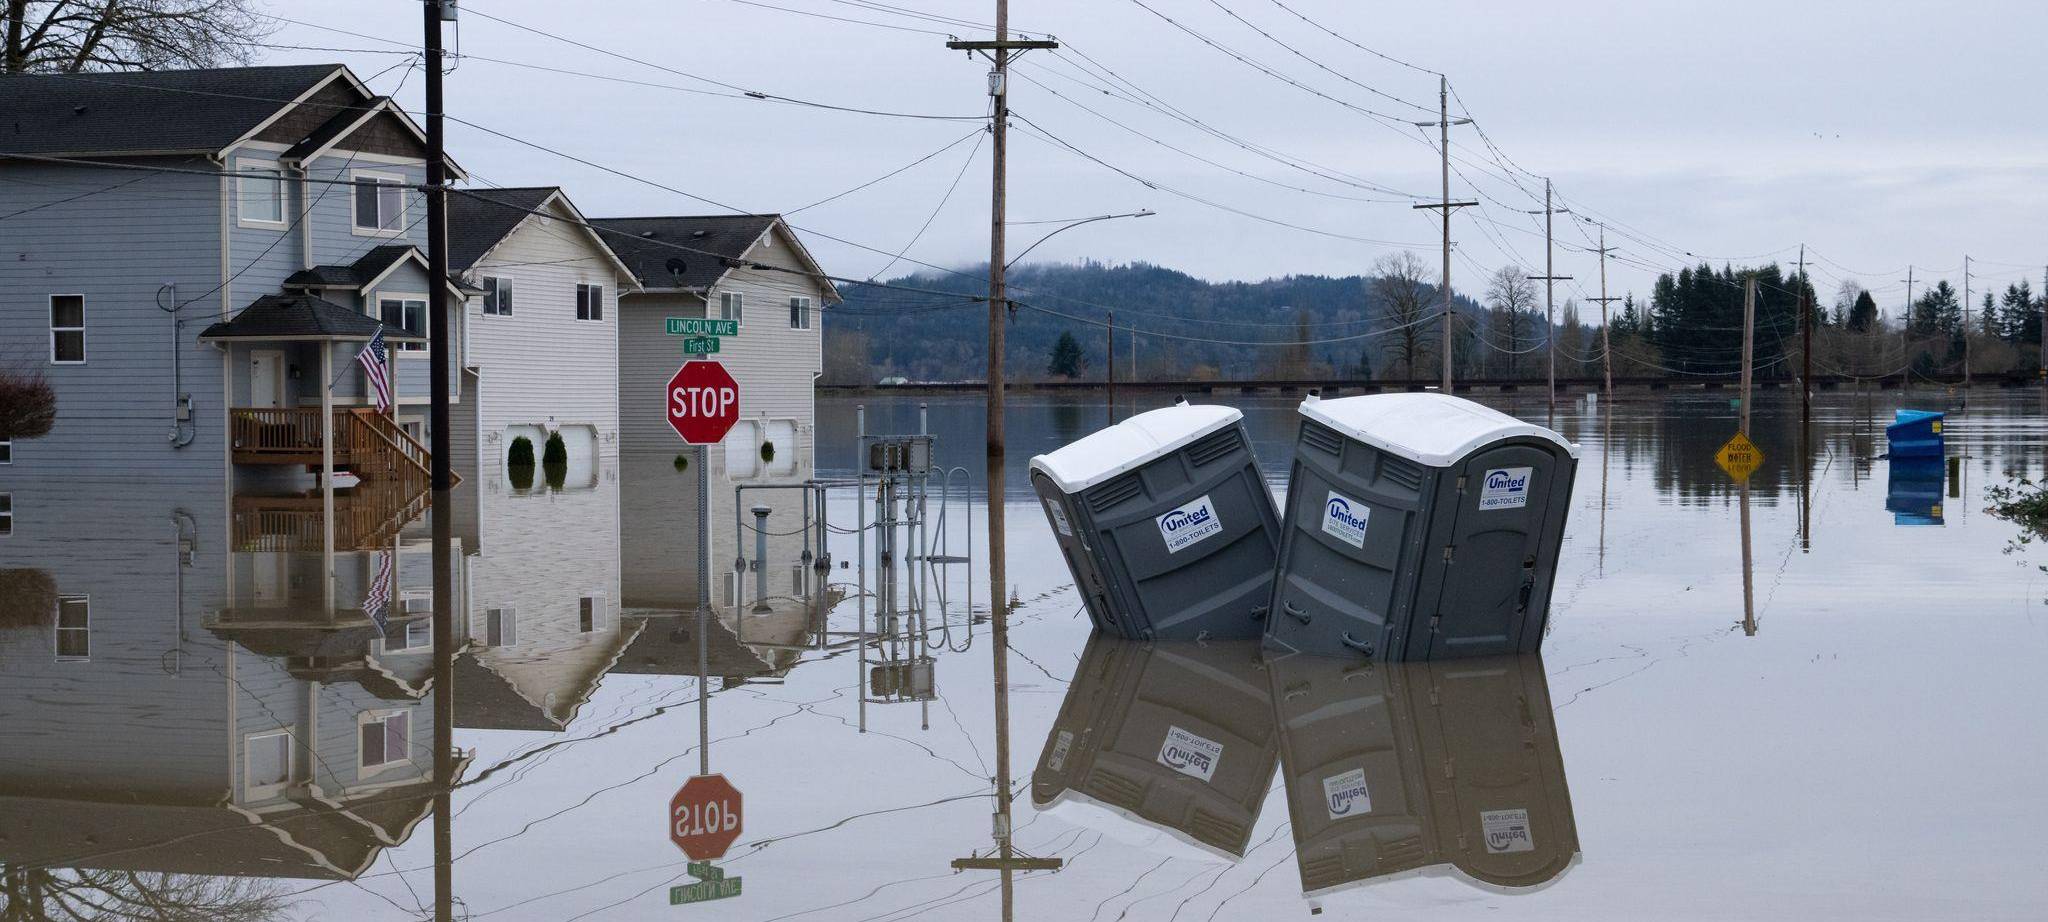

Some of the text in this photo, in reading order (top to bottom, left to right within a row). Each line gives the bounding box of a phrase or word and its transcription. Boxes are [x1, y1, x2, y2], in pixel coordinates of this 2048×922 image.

[671, 320, 733, 334] LINCOLN AVE
[689, 340, 714, 352] First St
[672, 386, 735, 418] STOP
[1728, 443, 1751, 451] FLOOD
[1489, 475, 1526, 489] United
[1482, 496, 1525, 506] 1-800-TOILETS
[1165, 505, 1209, 532] United
[1331, 503, 1366, 531] United
[1169, 522, 1219, 549] 1-800-TOILETS
